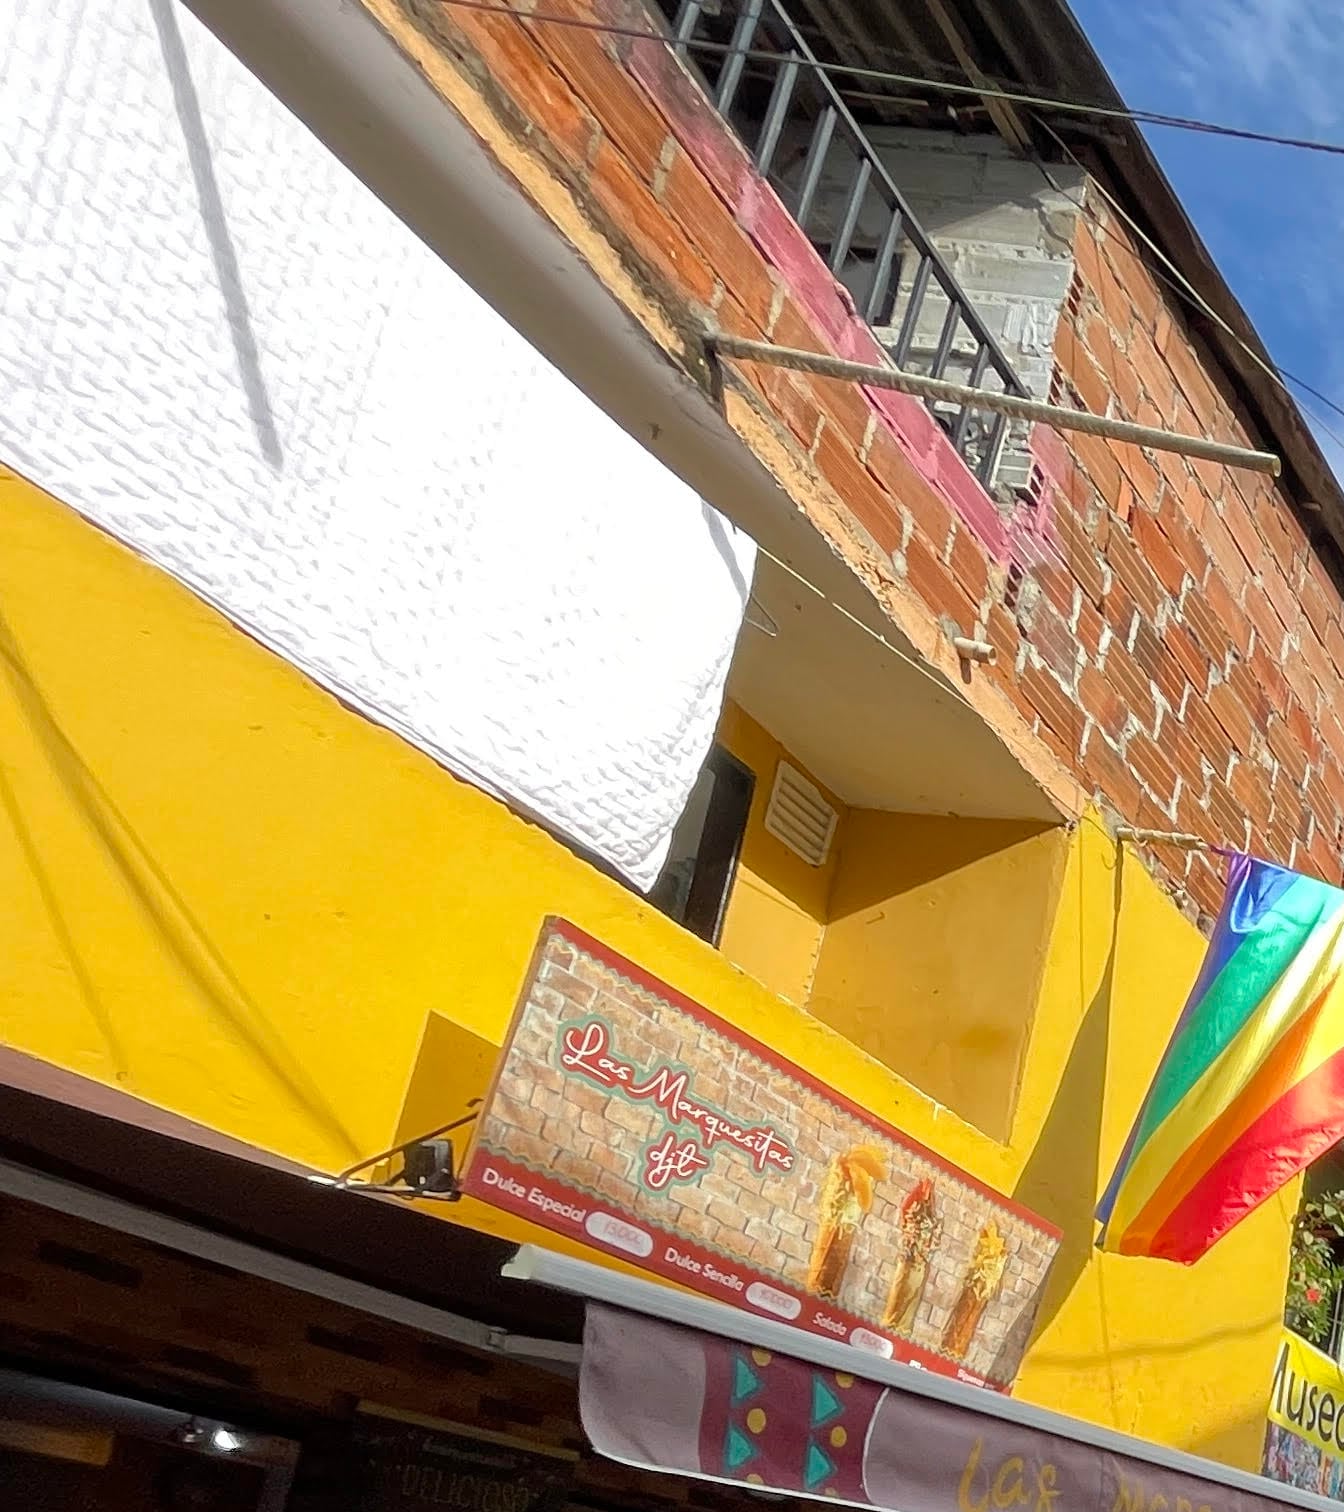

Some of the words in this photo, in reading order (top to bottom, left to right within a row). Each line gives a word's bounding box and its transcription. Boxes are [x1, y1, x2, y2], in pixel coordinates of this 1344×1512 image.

[562, 1023, 632, 1082] Las
[627, 1068, 794, 1169] Marquesitas
[481, 1168, 525, 1199] Dulce
[527, 1188, 588, 1223] Especial
[663, 1247, 702, 1273] Dulce
